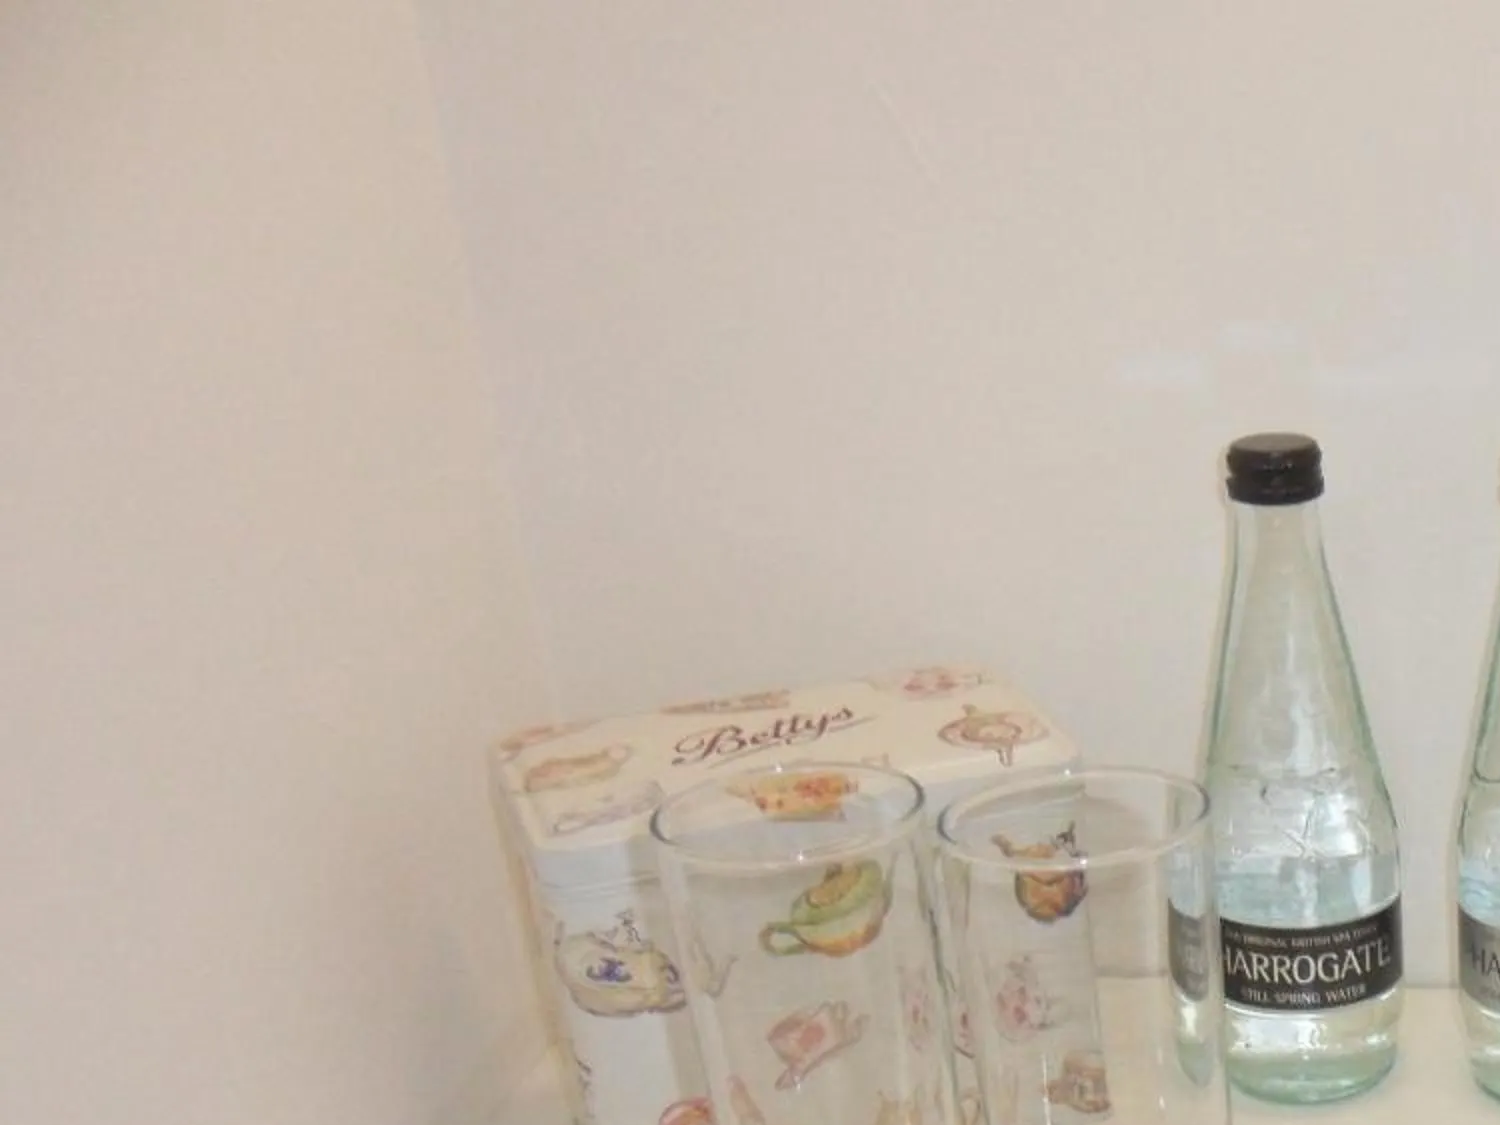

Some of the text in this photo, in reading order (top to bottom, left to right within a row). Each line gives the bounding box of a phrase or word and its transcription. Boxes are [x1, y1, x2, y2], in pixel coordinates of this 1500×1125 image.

[671, 706, 854, 766] Bettys
[1274, 990, 1321, 1005] SPRING
[1325, 983, 1367, 1003] WATER
